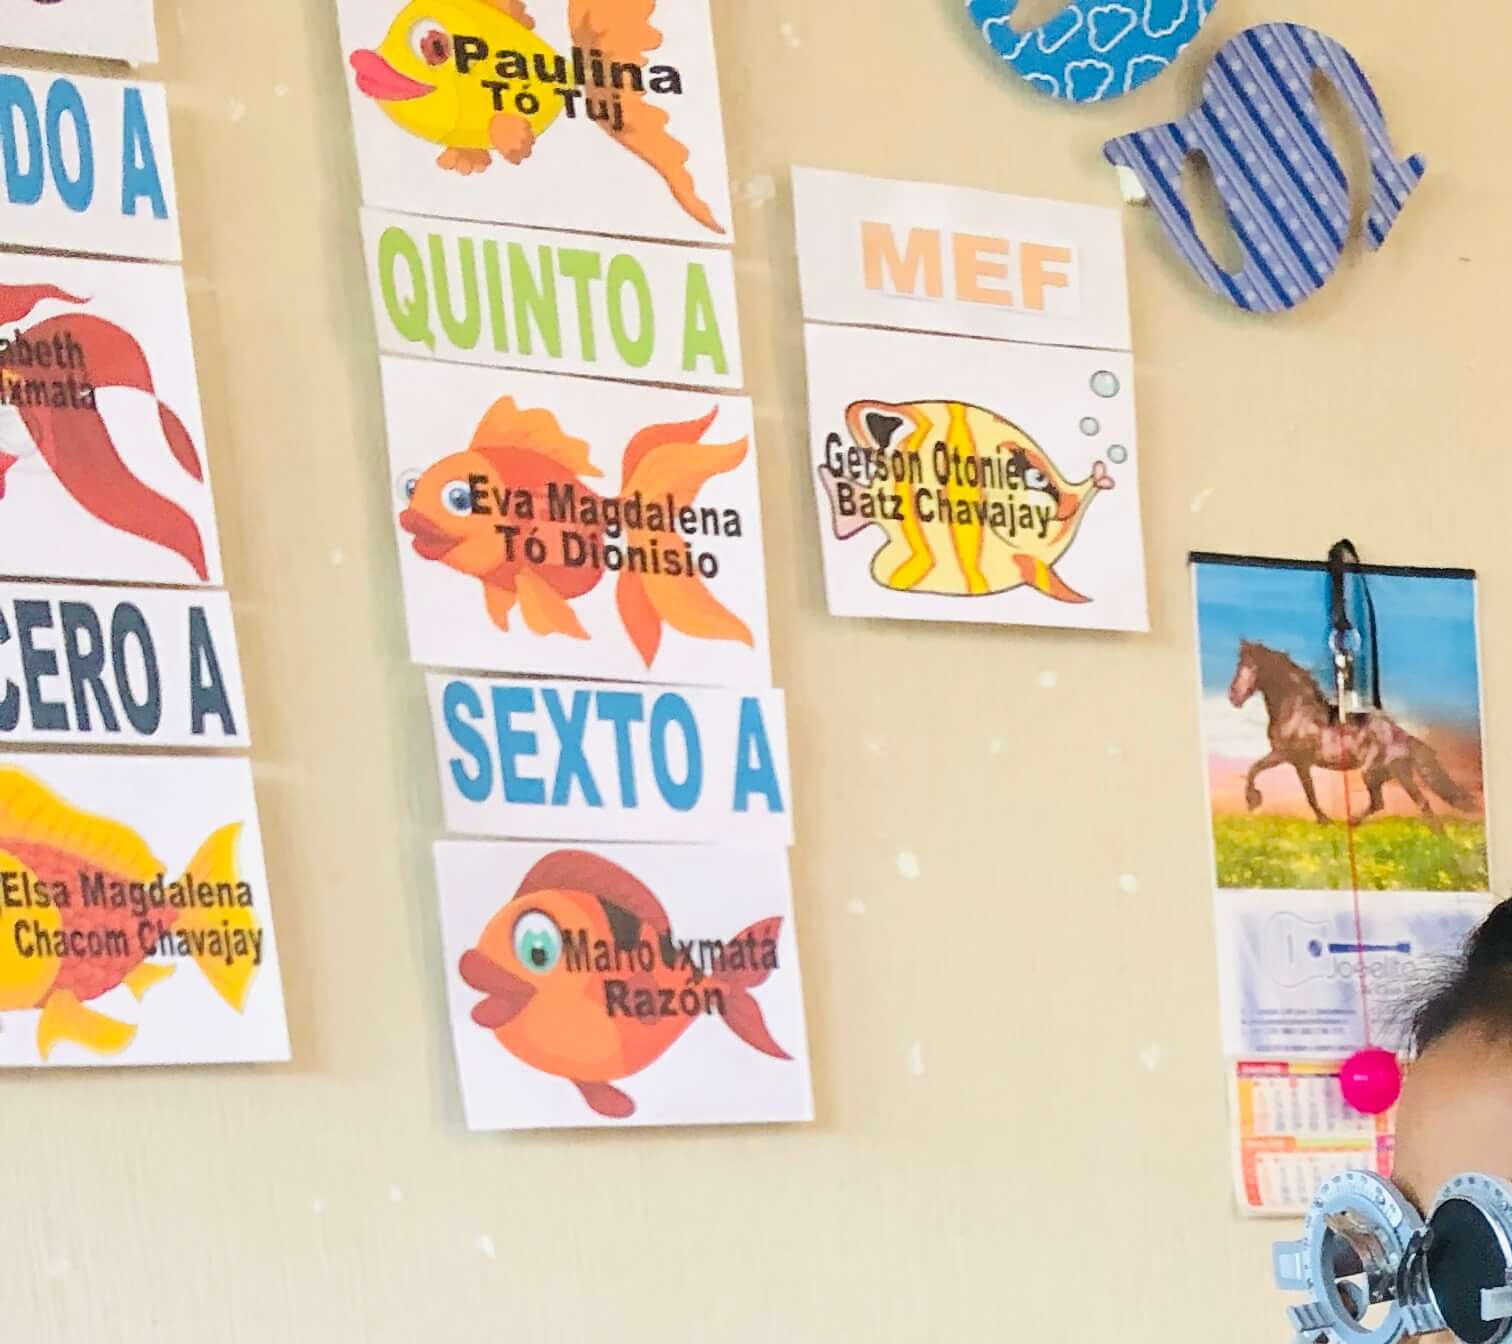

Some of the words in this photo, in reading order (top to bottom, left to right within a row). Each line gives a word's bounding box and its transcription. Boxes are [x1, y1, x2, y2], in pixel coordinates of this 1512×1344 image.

[453, 34, 683, 94] Paulina
[481, 80, 539, 114] Tó
[554, 88, 624, 131] Tuj
[122, 87, 169, 220] A
[861, 221, 1072, 311] MEF
[378, 226, 655, 368] QUINTO
[682, 262, 729, 374] A
[826, 432, 922, 483] Gerson
[933, 441, 1027, 490] Otonie
[468, 472, 534, 520] Eva
[548, 482, 742, 538] Magdalena
[837, 482, 904, 520] Batz
[915, 488, 1049, 537] Chavajay
[494, 524, 546, 564] Tó
[561, 530, 718, 579] Dionisio
[189, 606, 237, 735] A
[443, 681, 703, 811] SEXTO
[733, 697, 784, 812] A
[0, 872, 70, 907] Elsa
[80, 872, 253, 917] Magdalena
[15, 920, 129, 958] Chacom
[138, 919, 263, 966] Chavajay
[604, 975, 727, 1017] Razón
